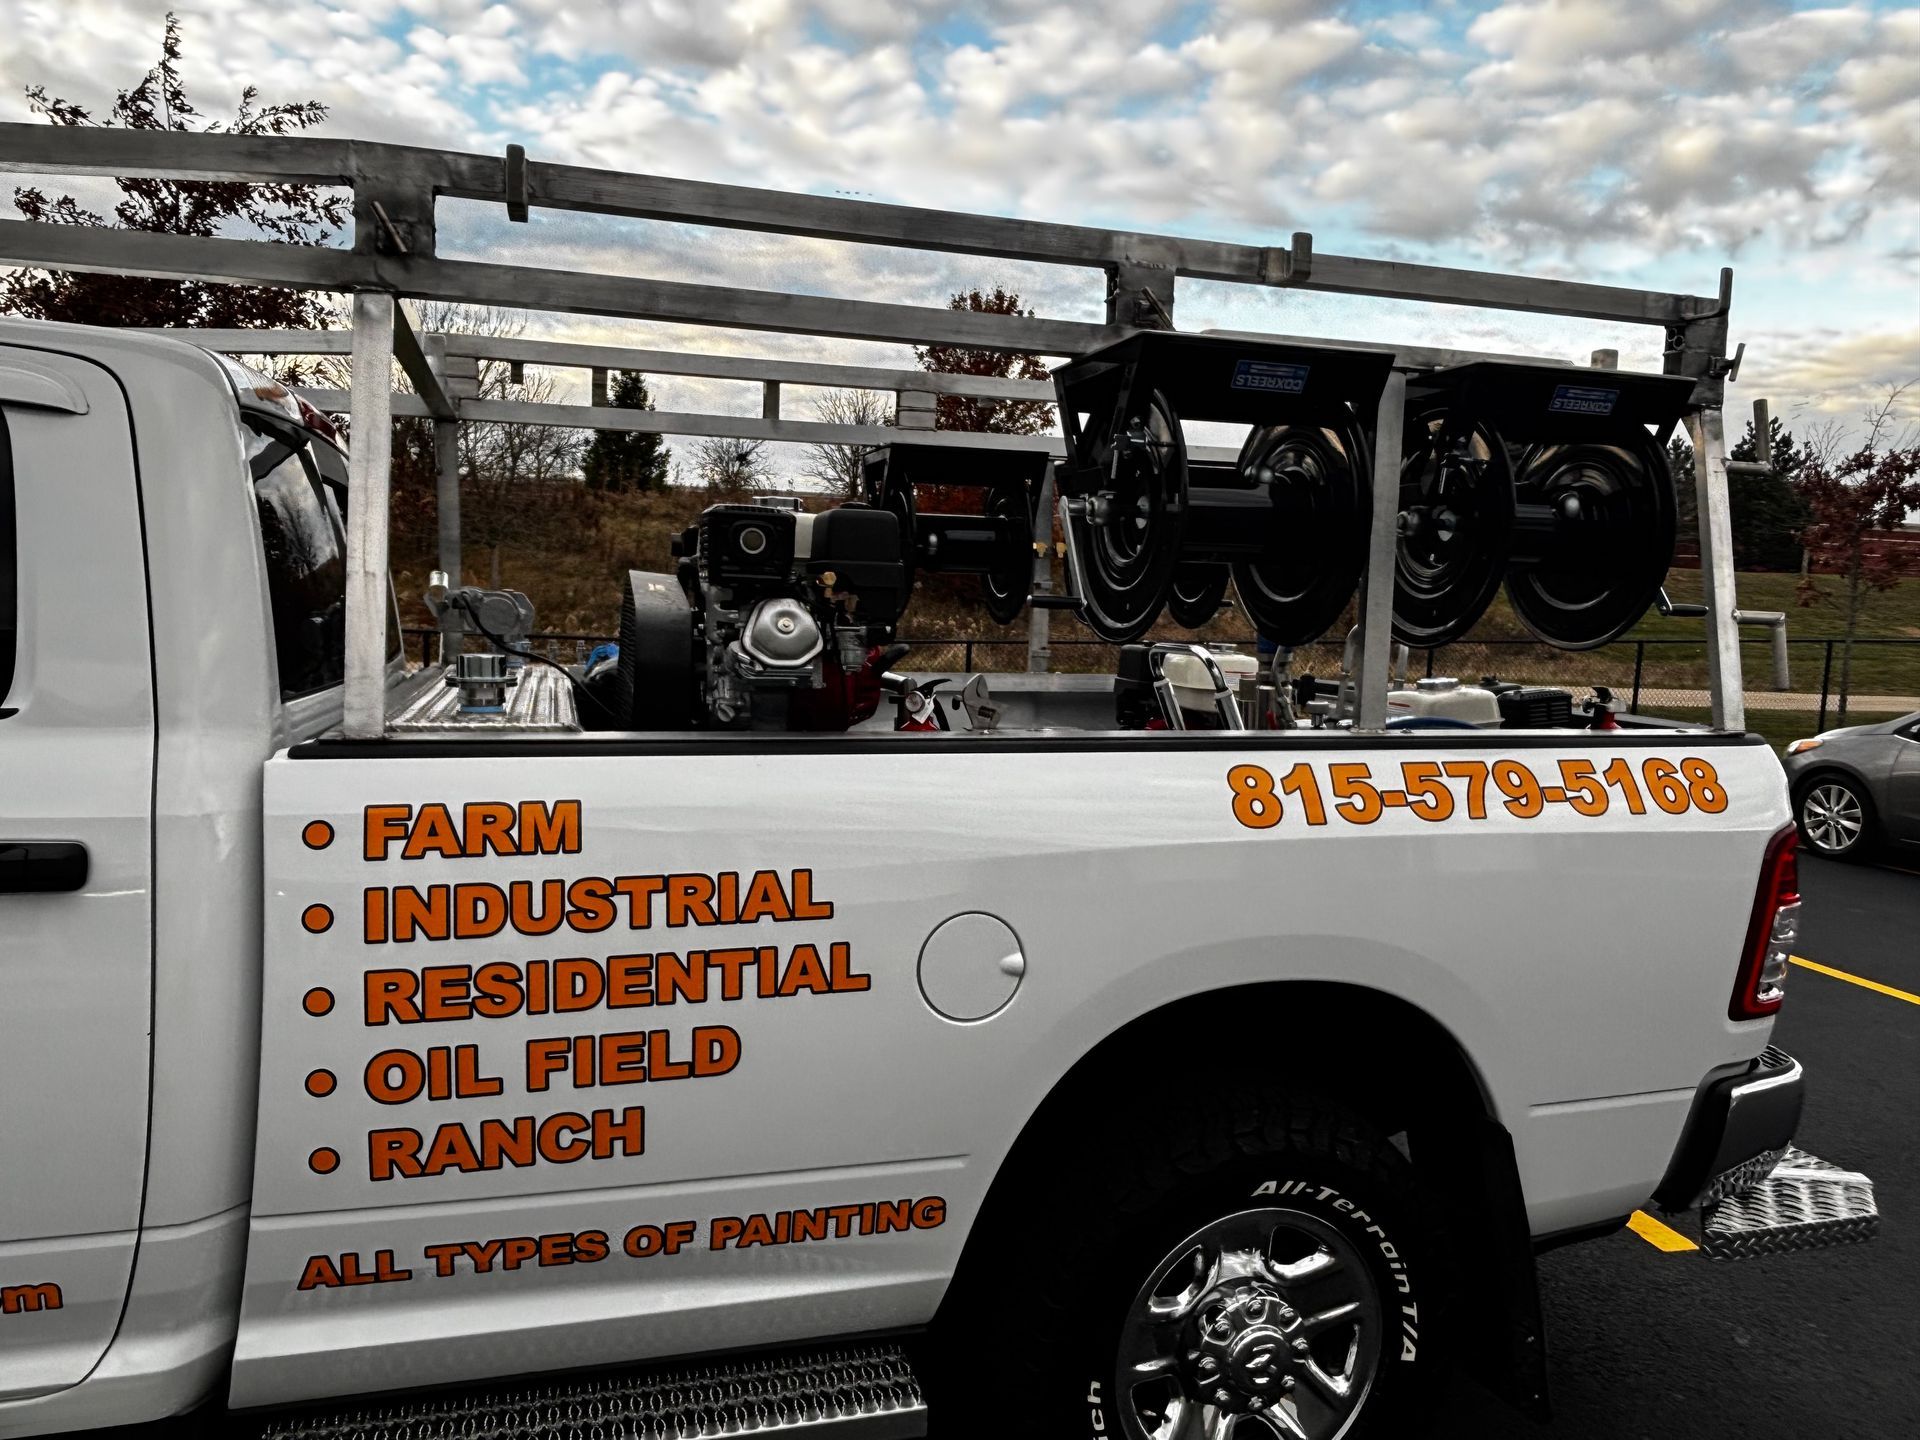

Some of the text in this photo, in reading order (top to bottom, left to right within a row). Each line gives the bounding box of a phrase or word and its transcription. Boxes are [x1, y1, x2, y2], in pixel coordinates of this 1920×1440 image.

[1234, 374, 1303, 391] COXREELS
[1551, 398, 1613, 413] COXREELS
[363, 799, 582, 861] FARM
[1226, 756, 1729, 830] 815-579-5168
[363, 868, 834, 944] INDUSTRIAL
[363, 942, 871, 1026] RESIDENTIAL
[363, 1025, 742, 1105] OIL FIELD
[368, 1105, 646, 1182] RANCH
[297, 1195, 948, 1291] ALL TYPES OF PAINTING
[1251, 1180, 1419, 1362] All-Terrain T/A
[0, 1282, 64, 1314] m
